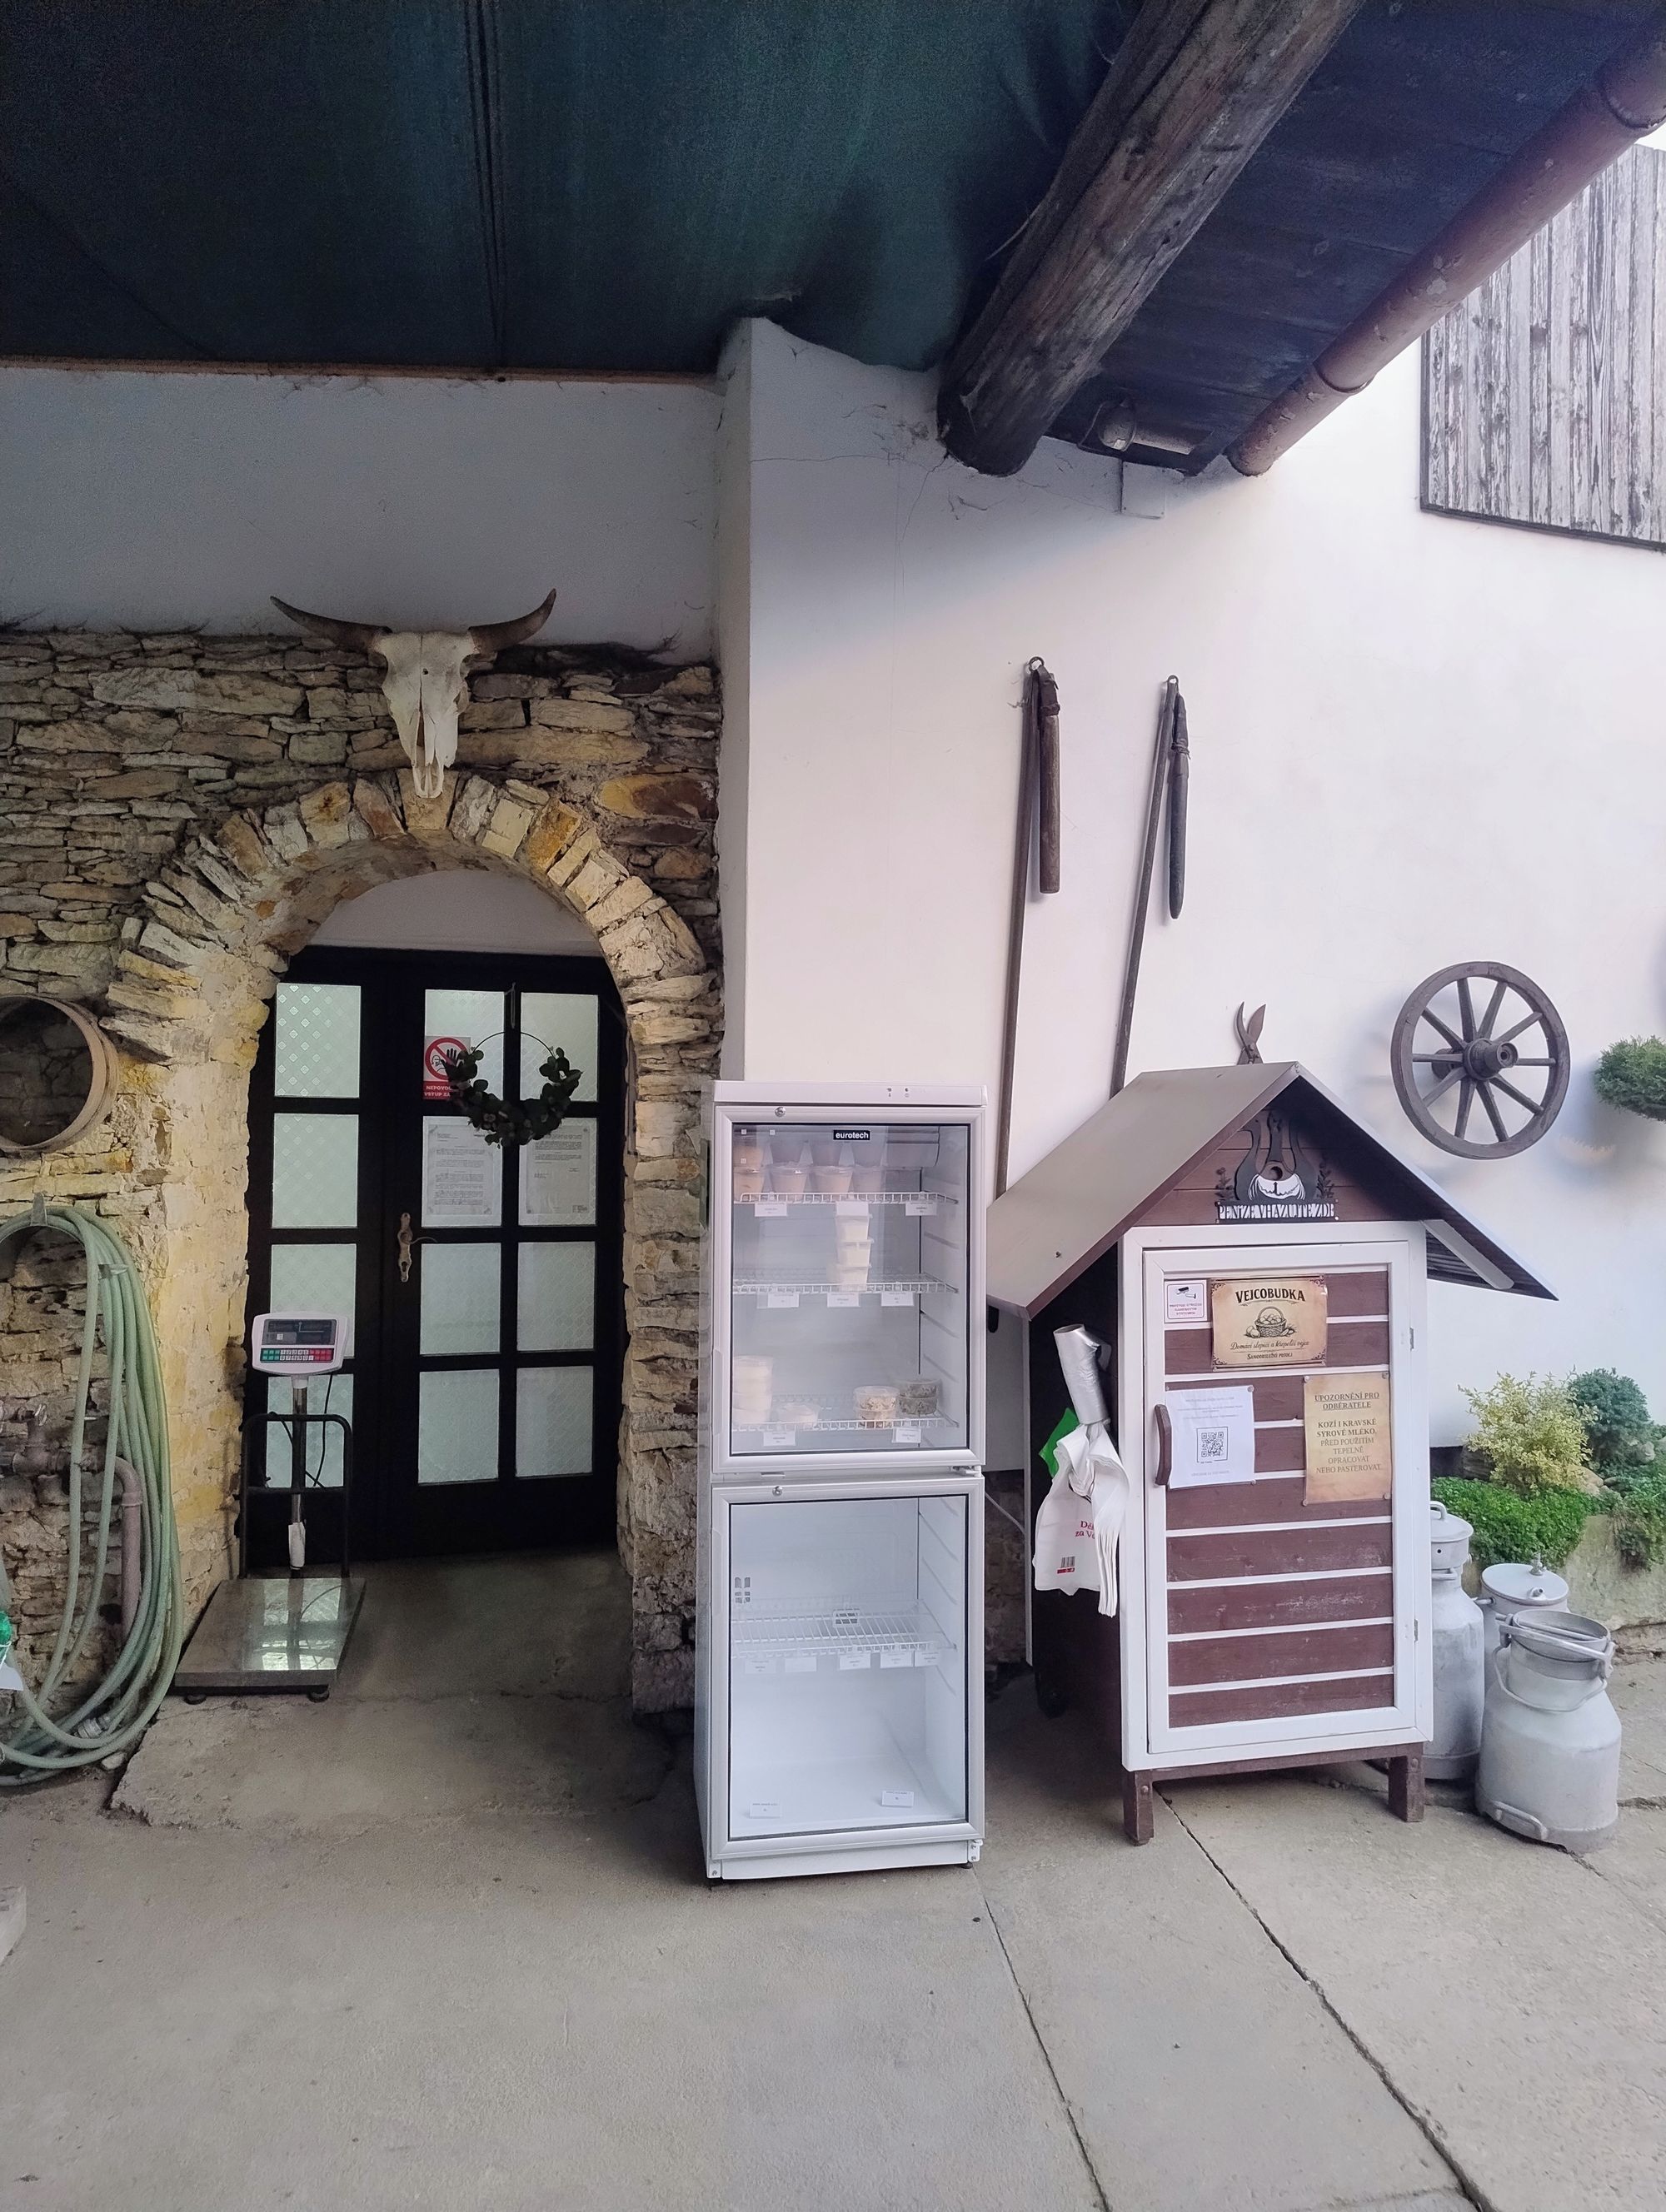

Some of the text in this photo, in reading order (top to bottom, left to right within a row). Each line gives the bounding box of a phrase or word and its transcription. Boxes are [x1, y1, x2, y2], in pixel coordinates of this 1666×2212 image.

[835, 1131, 870, 1140] eurotech
[1235, 1288, 1306, 1303] VEJCOBUDKA
[1318, 1419, 1336, 1428] KOZÍ
[1343, 1417, 1377, 1427] KRAVSKÉ
[1328, 1456, 1369, 1464] OPRACOVAT
